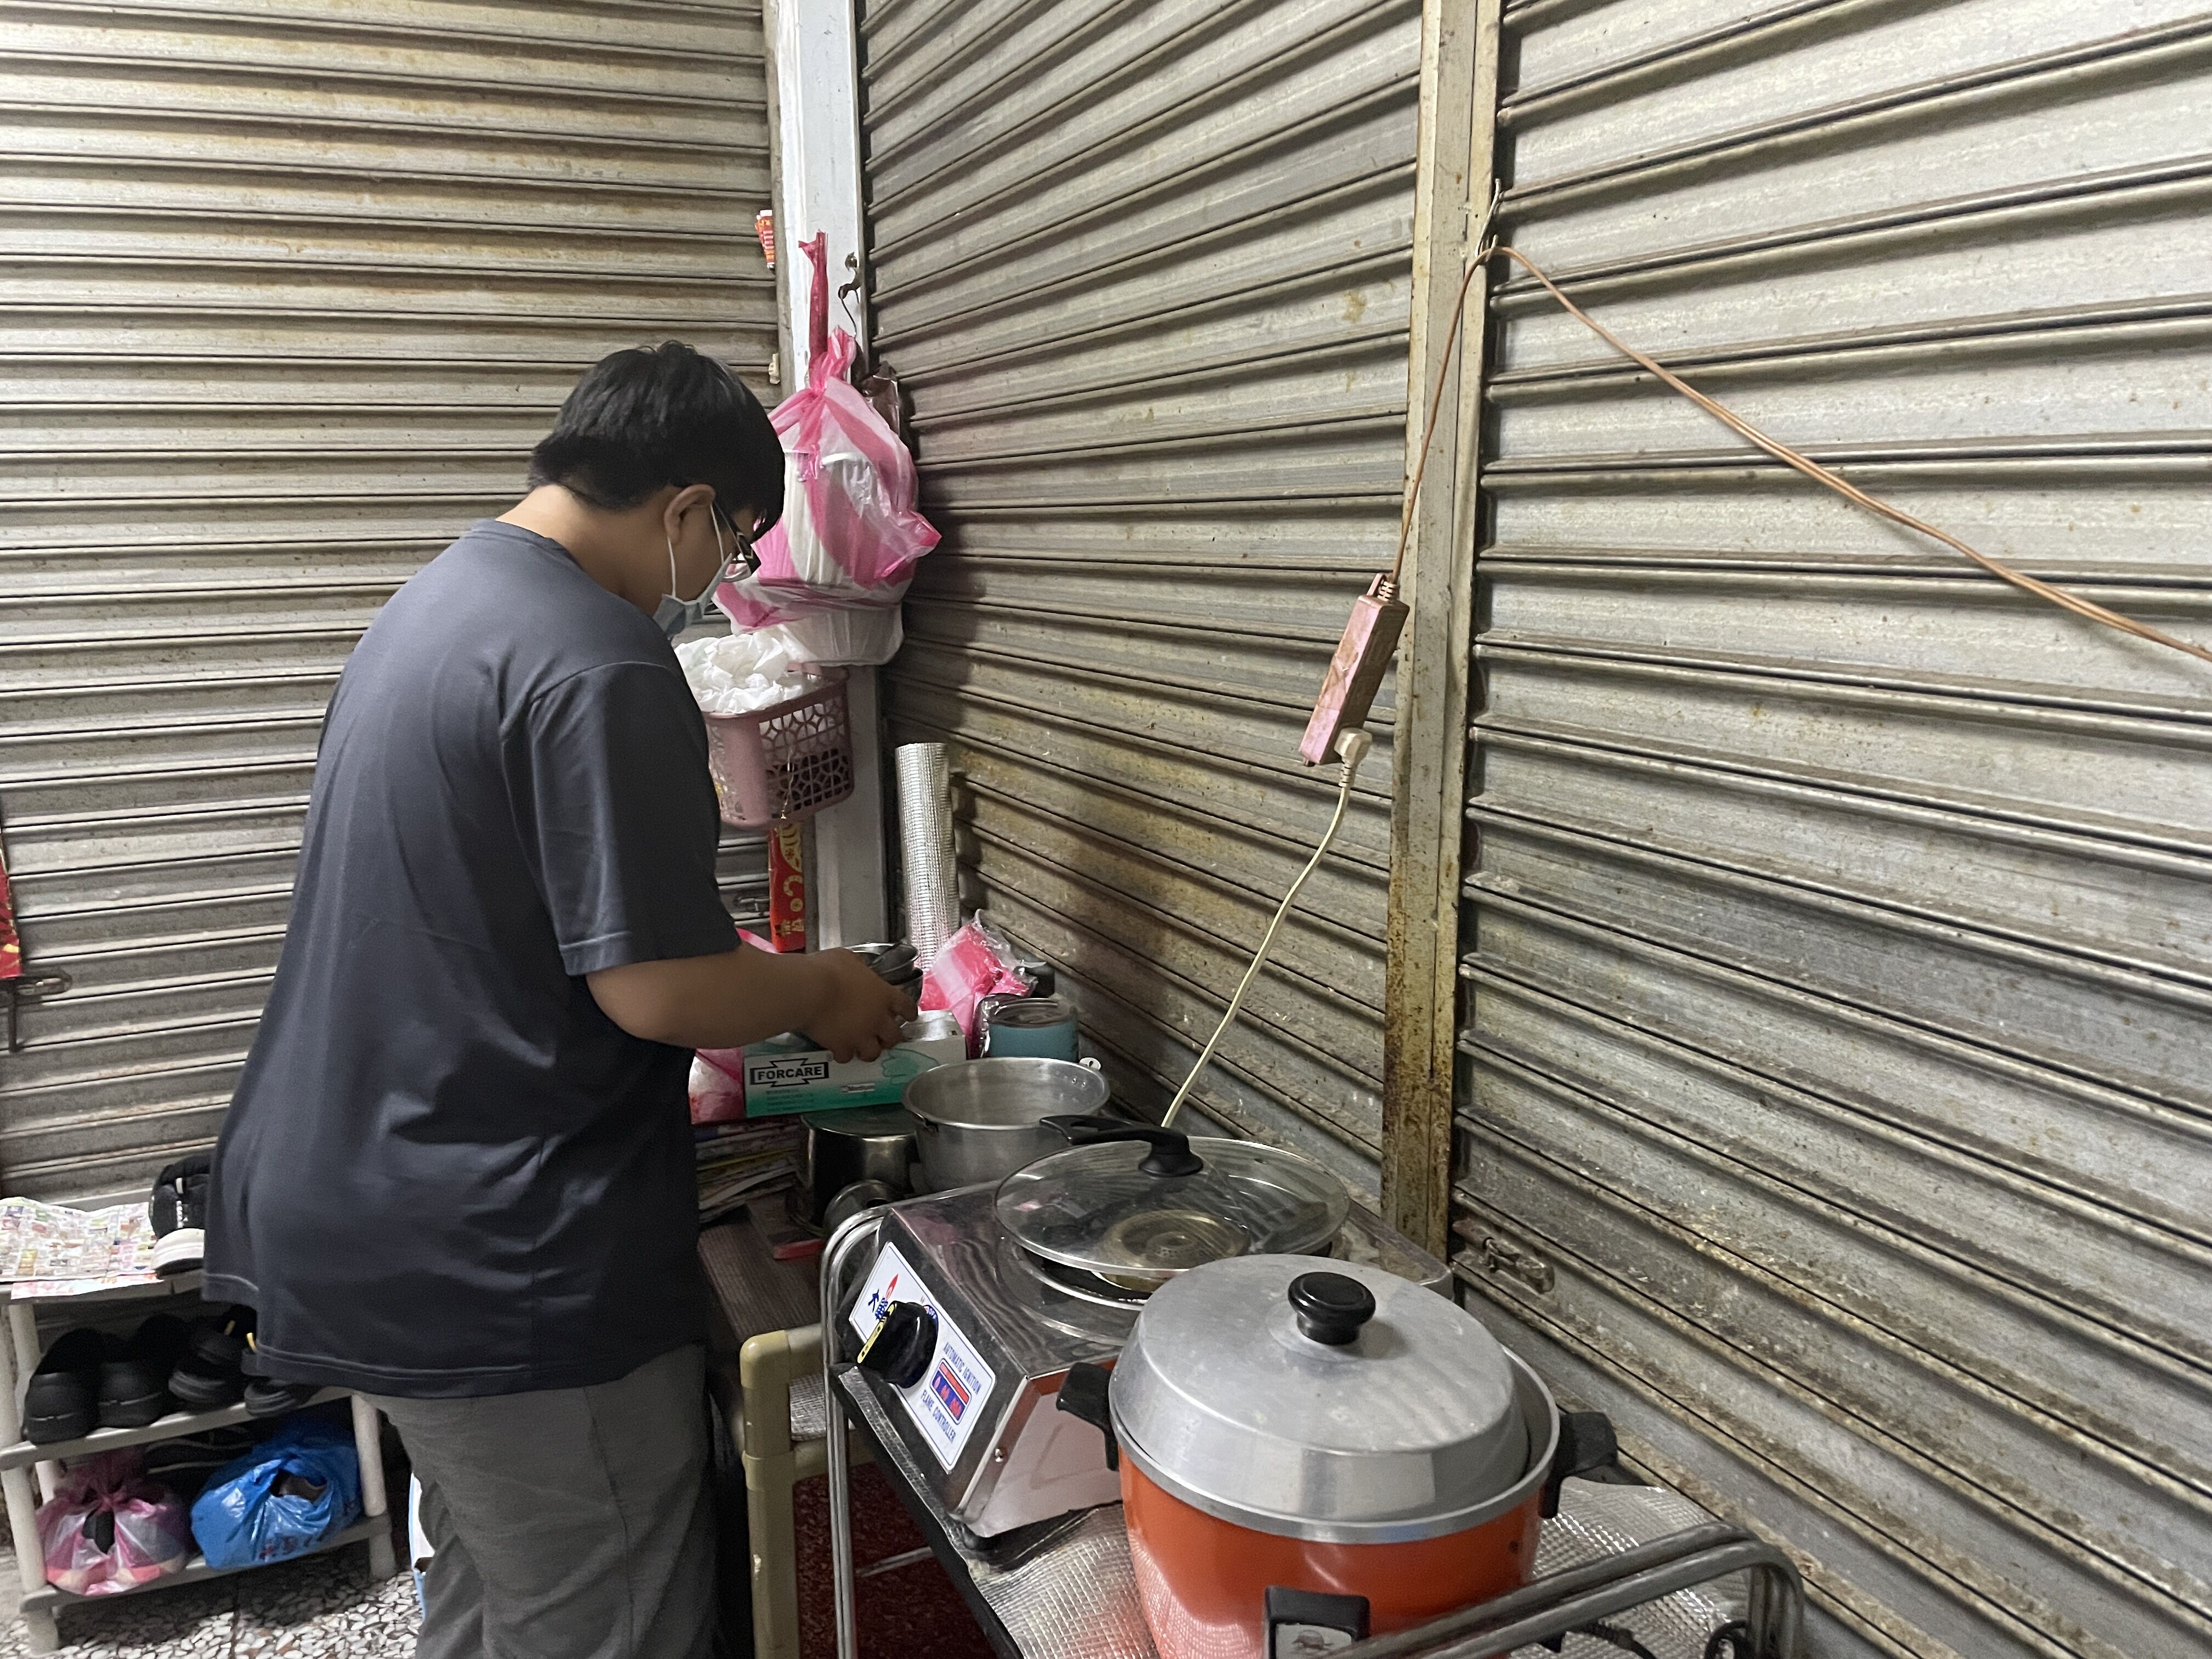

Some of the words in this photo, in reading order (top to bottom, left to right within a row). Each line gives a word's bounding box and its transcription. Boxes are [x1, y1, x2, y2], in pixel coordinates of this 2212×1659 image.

[758, 1066, 822, 1081] FORCARE
[943, 1342, 965, 1373] AUTOMATIC
[962, 1367, 982, 1395] IGNITION
[921, 1389, 934, 1411] FLAME
[932, 1406, 956, 1444] CONTROLLER
